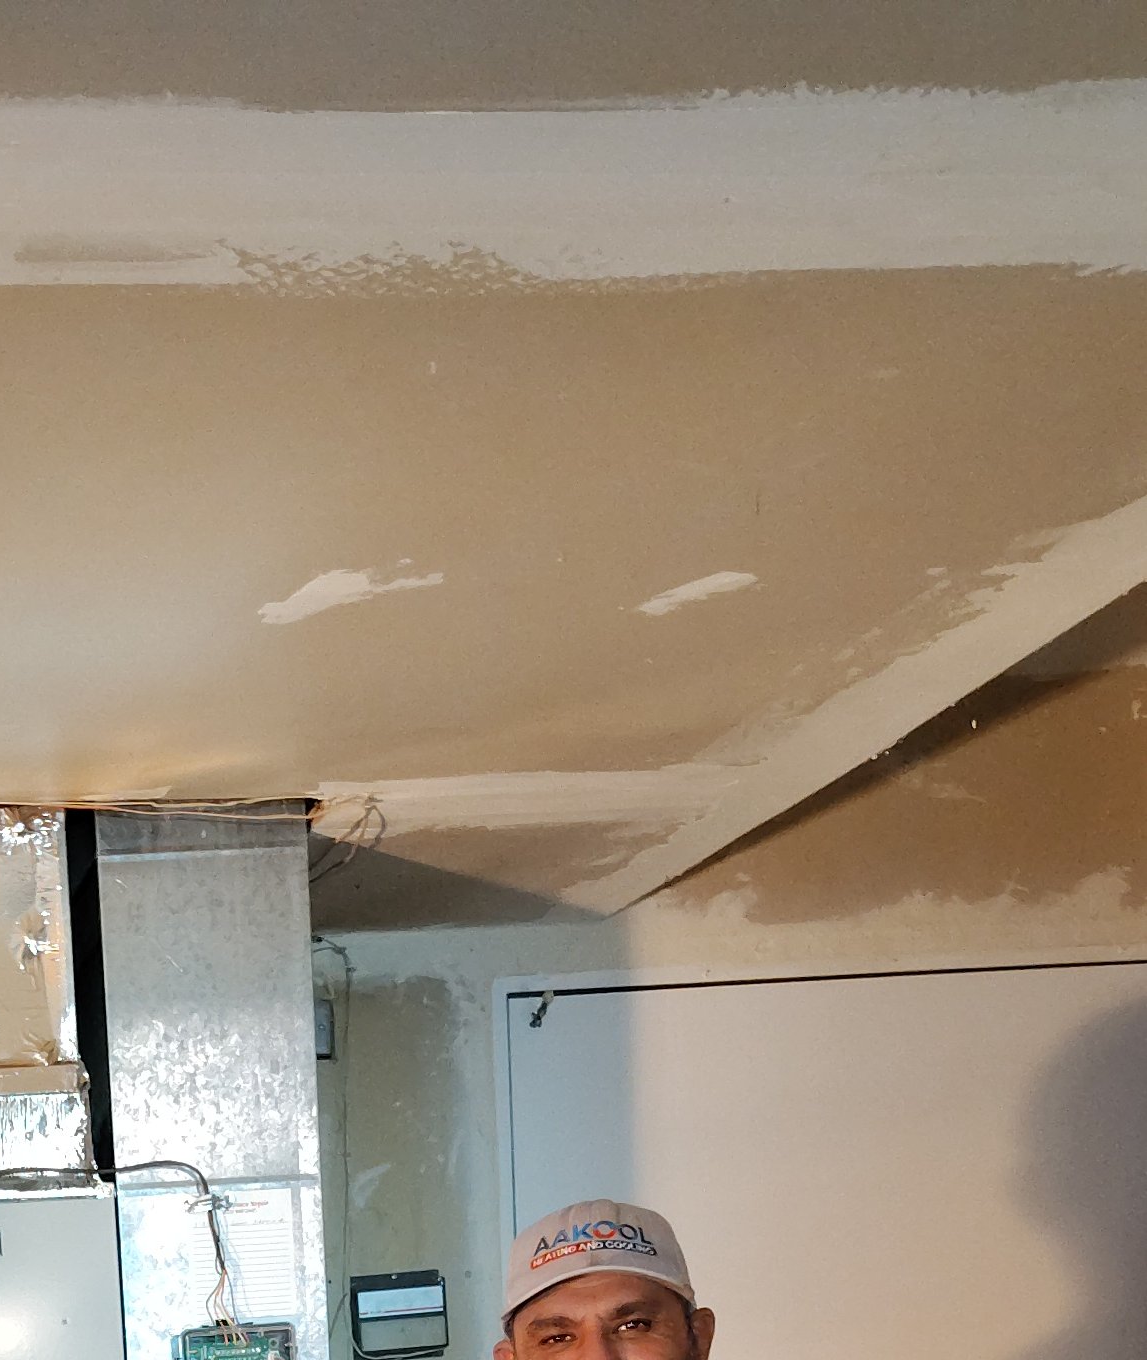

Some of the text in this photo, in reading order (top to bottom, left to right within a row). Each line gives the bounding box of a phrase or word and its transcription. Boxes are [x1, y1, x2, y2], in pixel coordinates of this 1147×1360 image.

[533, 1220, 652, 1256] AAKOOL
[531, 1246, 576, 1268] HEATING
[578, 1241, 603, 1251] AND
